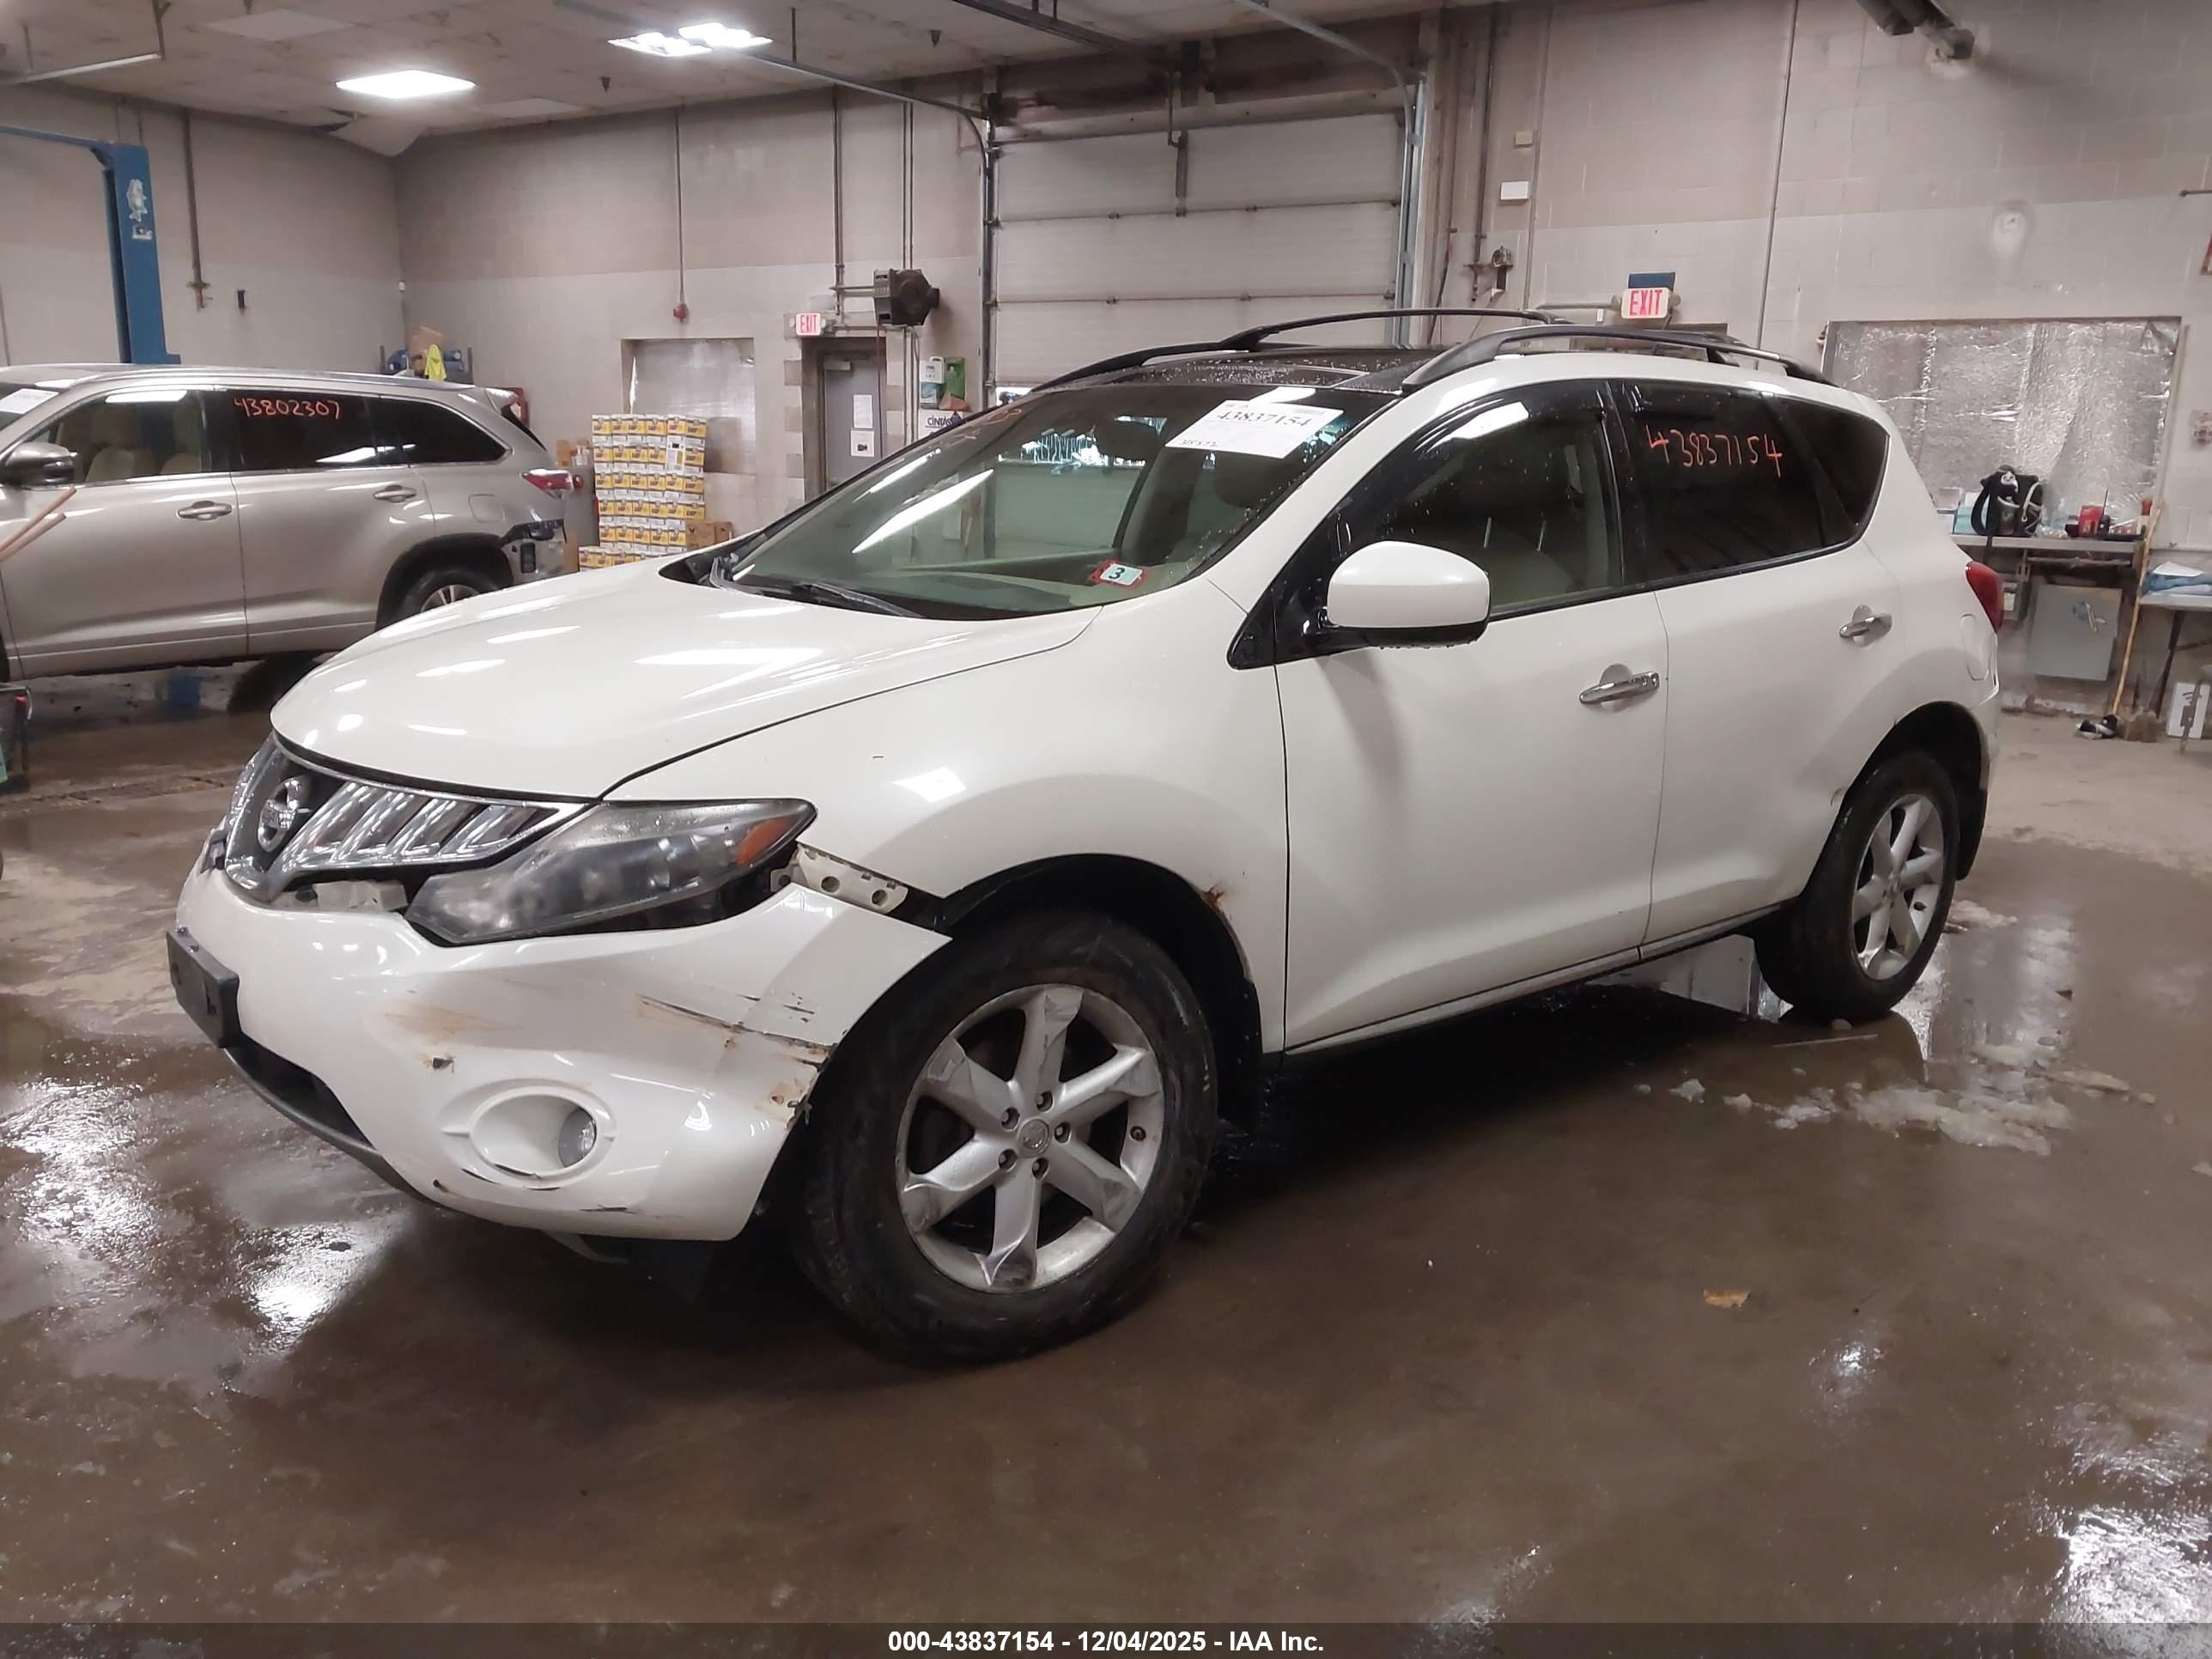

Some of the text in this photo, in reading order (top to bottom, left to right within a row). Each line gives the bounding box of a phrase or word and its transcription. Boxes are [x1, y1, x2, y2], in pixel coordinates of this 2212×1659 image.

[1630, 289, 1662, 315] EXIT
[800, 314, 817, 333] EXIT
[234, 398, 340, 419] 43802307
[1217, 410, 1313, 427] 43837154
[1645, 424, 1783, 477] 43837154
[1109, 567, 1126, 580] 3
